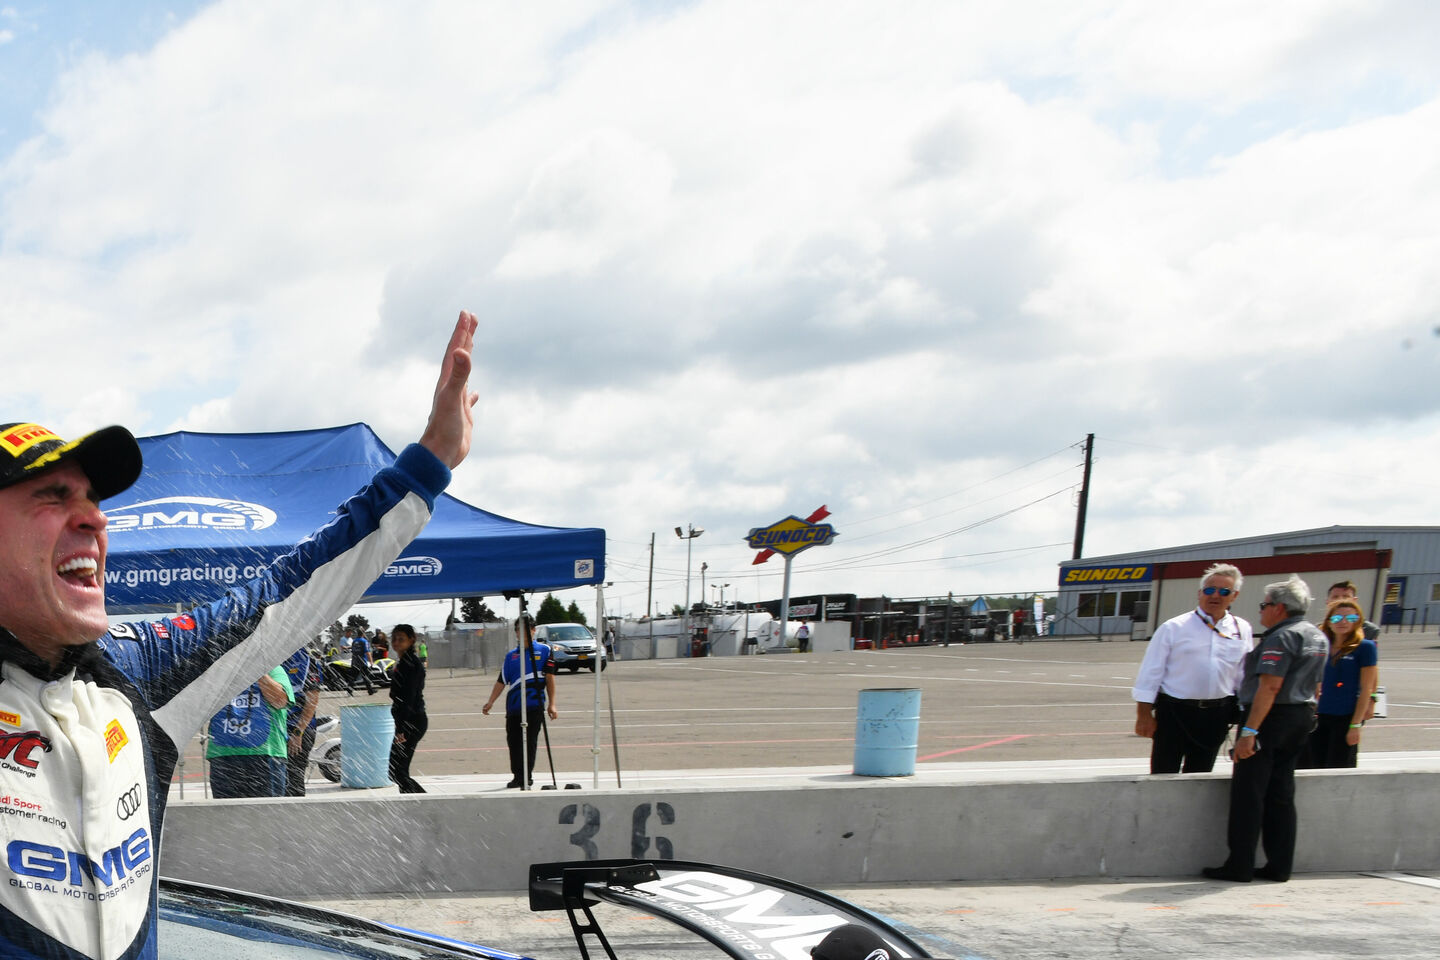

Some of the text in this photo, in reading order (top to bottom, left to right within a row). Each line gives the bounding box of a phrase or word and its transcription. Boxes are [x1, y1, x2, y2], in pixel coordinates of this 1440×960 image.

[754, 528, 828, 544] SUNOCO
[105, 563, 267, 588] w.gmgracing.co
[384, 564, 433, 575] GMG
[1064, 567, 1148, 582] SUNOCO
[2, 762, 36, 778] Challenge
[14, 798, 42, 812] Sport
[38, 814, 67, 829] racing
[558, 802, 676, 860] 36
[6, 828, 151, 887] GMG
[9, 878, 59, 893] GLOBAL
